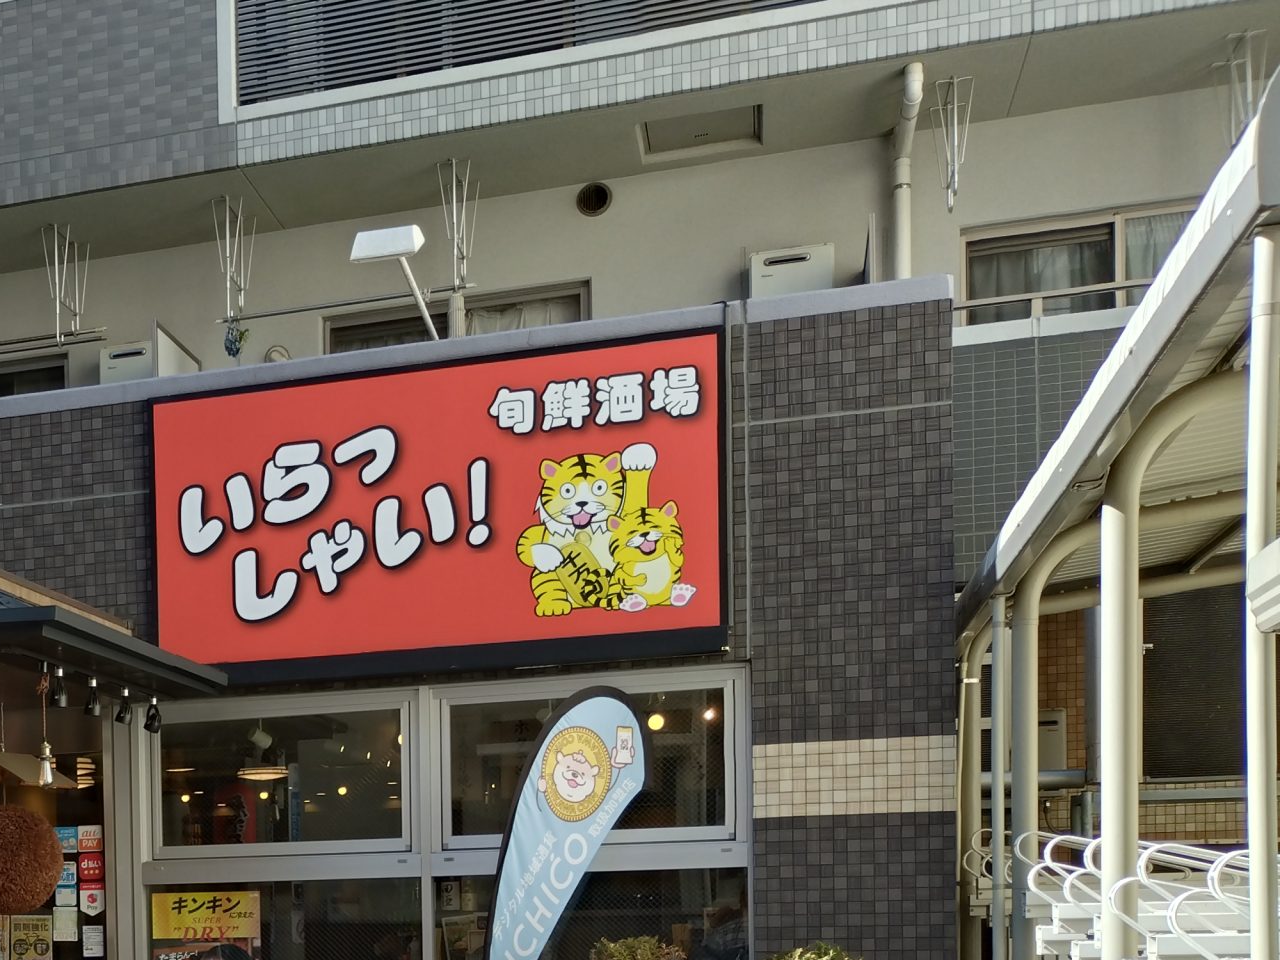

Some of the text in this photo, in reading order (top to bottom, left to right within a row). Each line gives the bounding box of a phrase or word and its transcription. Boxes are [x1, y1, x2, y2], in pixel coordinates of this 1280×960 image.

[488, 366, 699, 434] 旬鮮酒場
[179, 425, 398, 555] いらっ
[233, 457, 492, 622] しゃい!
[81, 828, 99, 837] au
[82, 839, 98, 847] PAY
[493, 830, 559, 942] デジタル地域通貨
[171, 896, 240, 915] キンキン
[229, 911, 255, 919] に冷えた
[192, 916, 222, 924] SUPER
